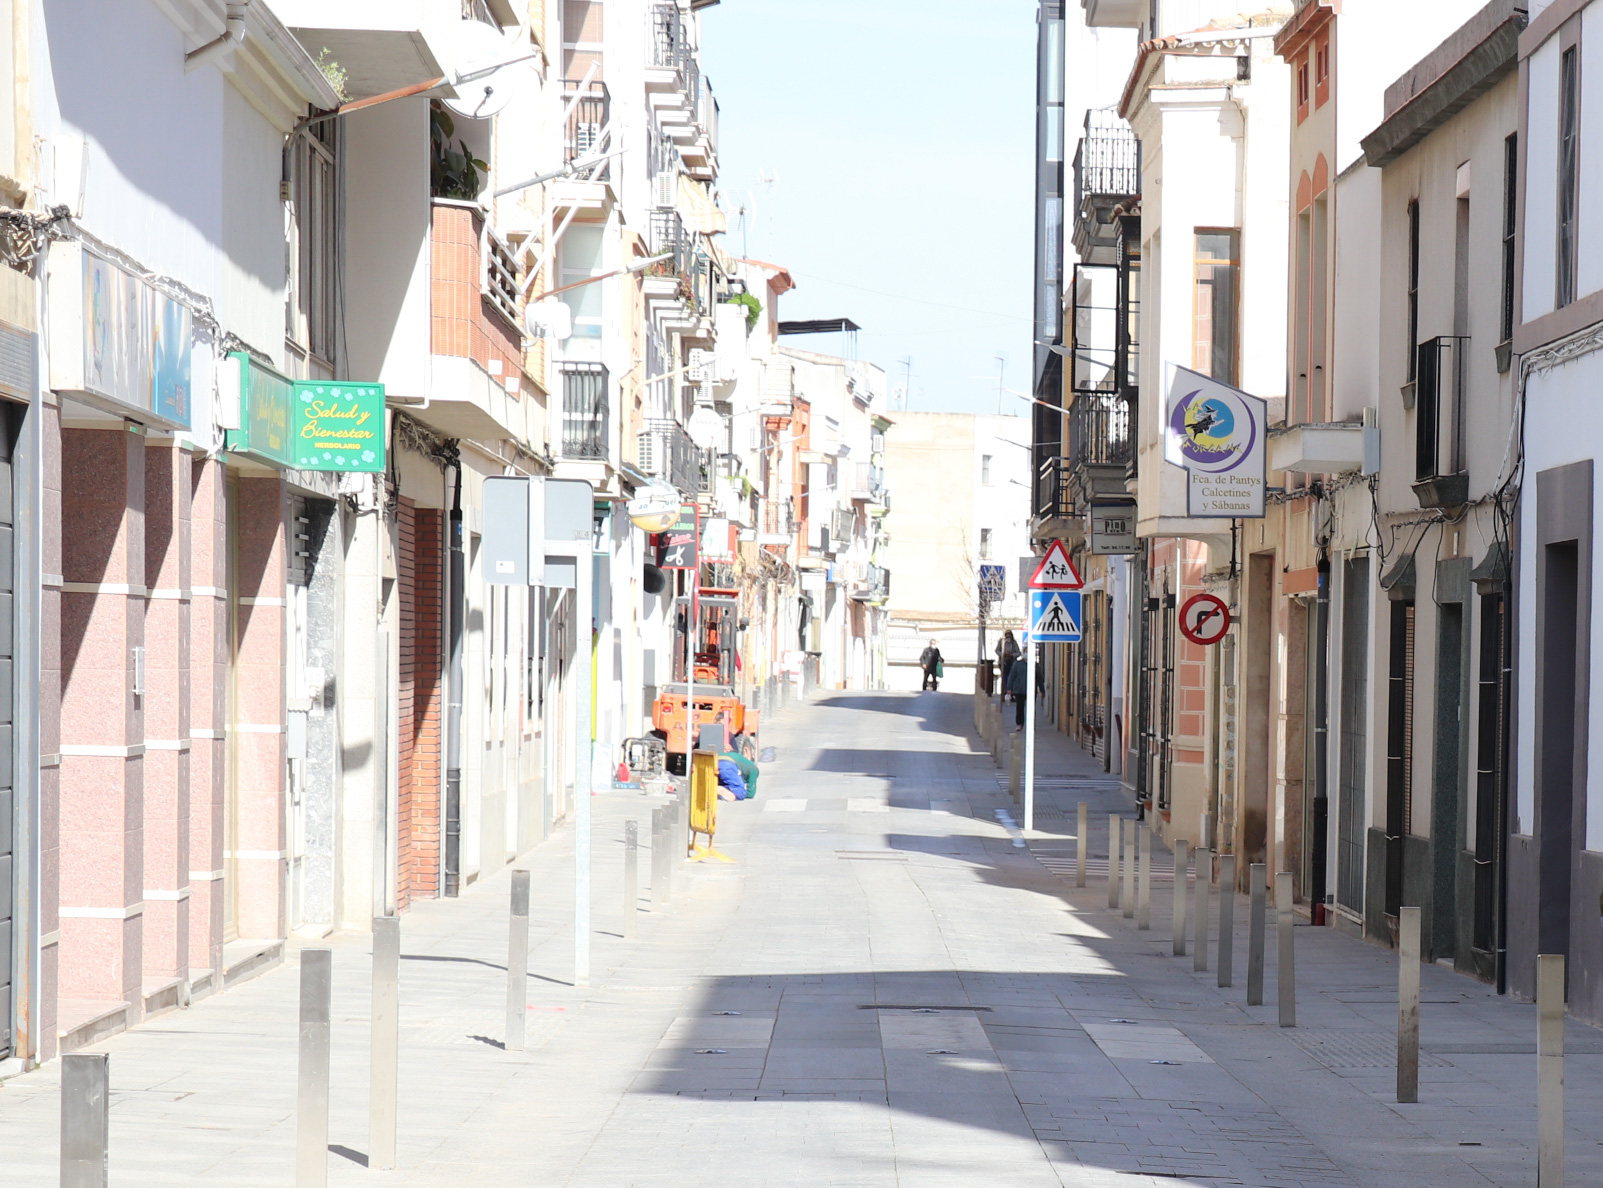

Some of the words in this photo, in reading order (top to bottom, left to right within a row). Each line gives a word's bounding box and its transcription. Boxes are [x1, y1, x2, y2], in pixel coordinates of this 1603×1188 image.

[304, 400, 358, 419] Salud
[356, 411, 372, 426] y
[300, 420, 375, 439] Bienestar
[314, 442, 362, 450] HERBOLARIO
[1192, 475, 1212, 484] Fca.
[1215, 475, 1227, 485] de
[1229, 475, 1261, 487] Pantys
[1201, 487, 1251, 497] Calcetines
[1202, 502, 1210, 512] y
[1211, 499, 1251, 510] Sábanas
